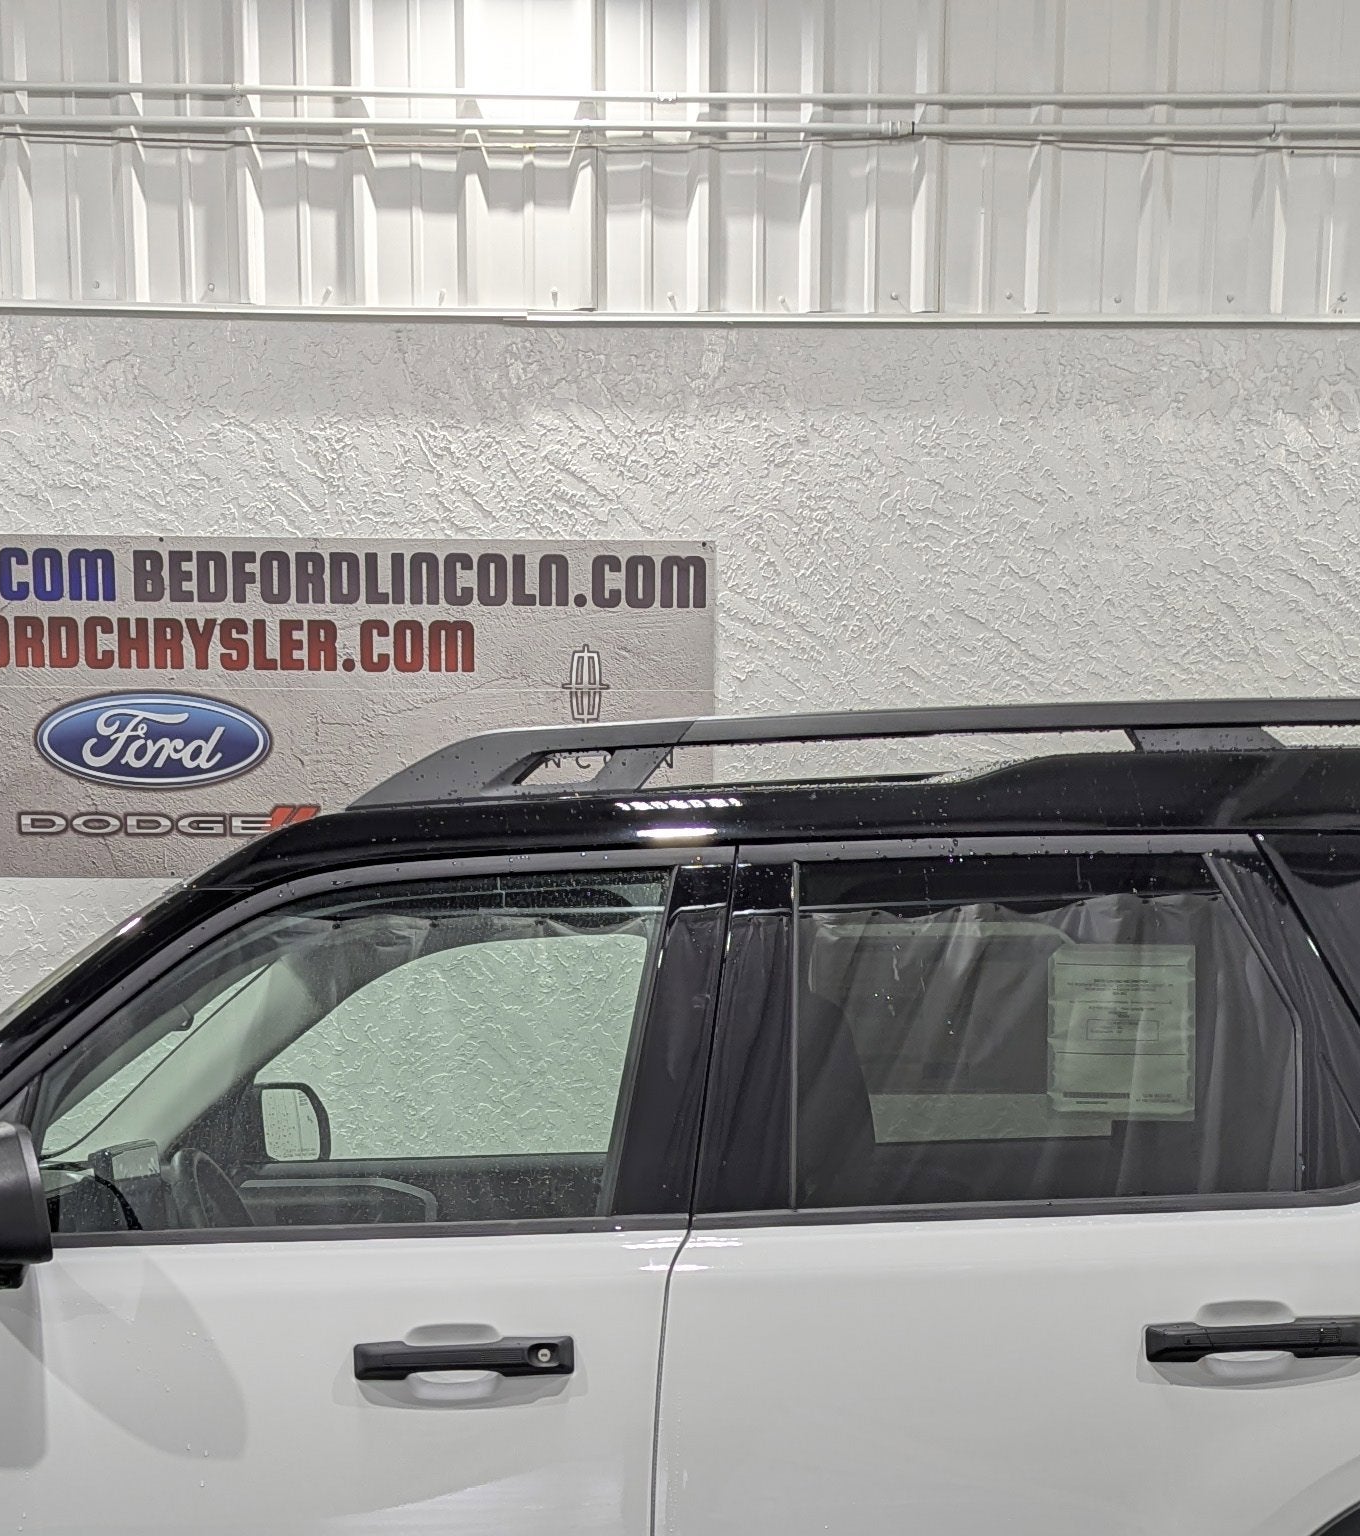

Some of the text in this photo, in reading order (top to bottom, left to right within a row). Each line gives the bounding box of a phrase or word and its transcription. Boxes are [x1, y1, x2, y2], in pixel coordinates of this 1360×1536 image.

[132, 550, 707, 608] BEDFORDLINCOLN.COM
[81, 708, 226, 768] Ford
[19, 812, 273, 836] DODGE
